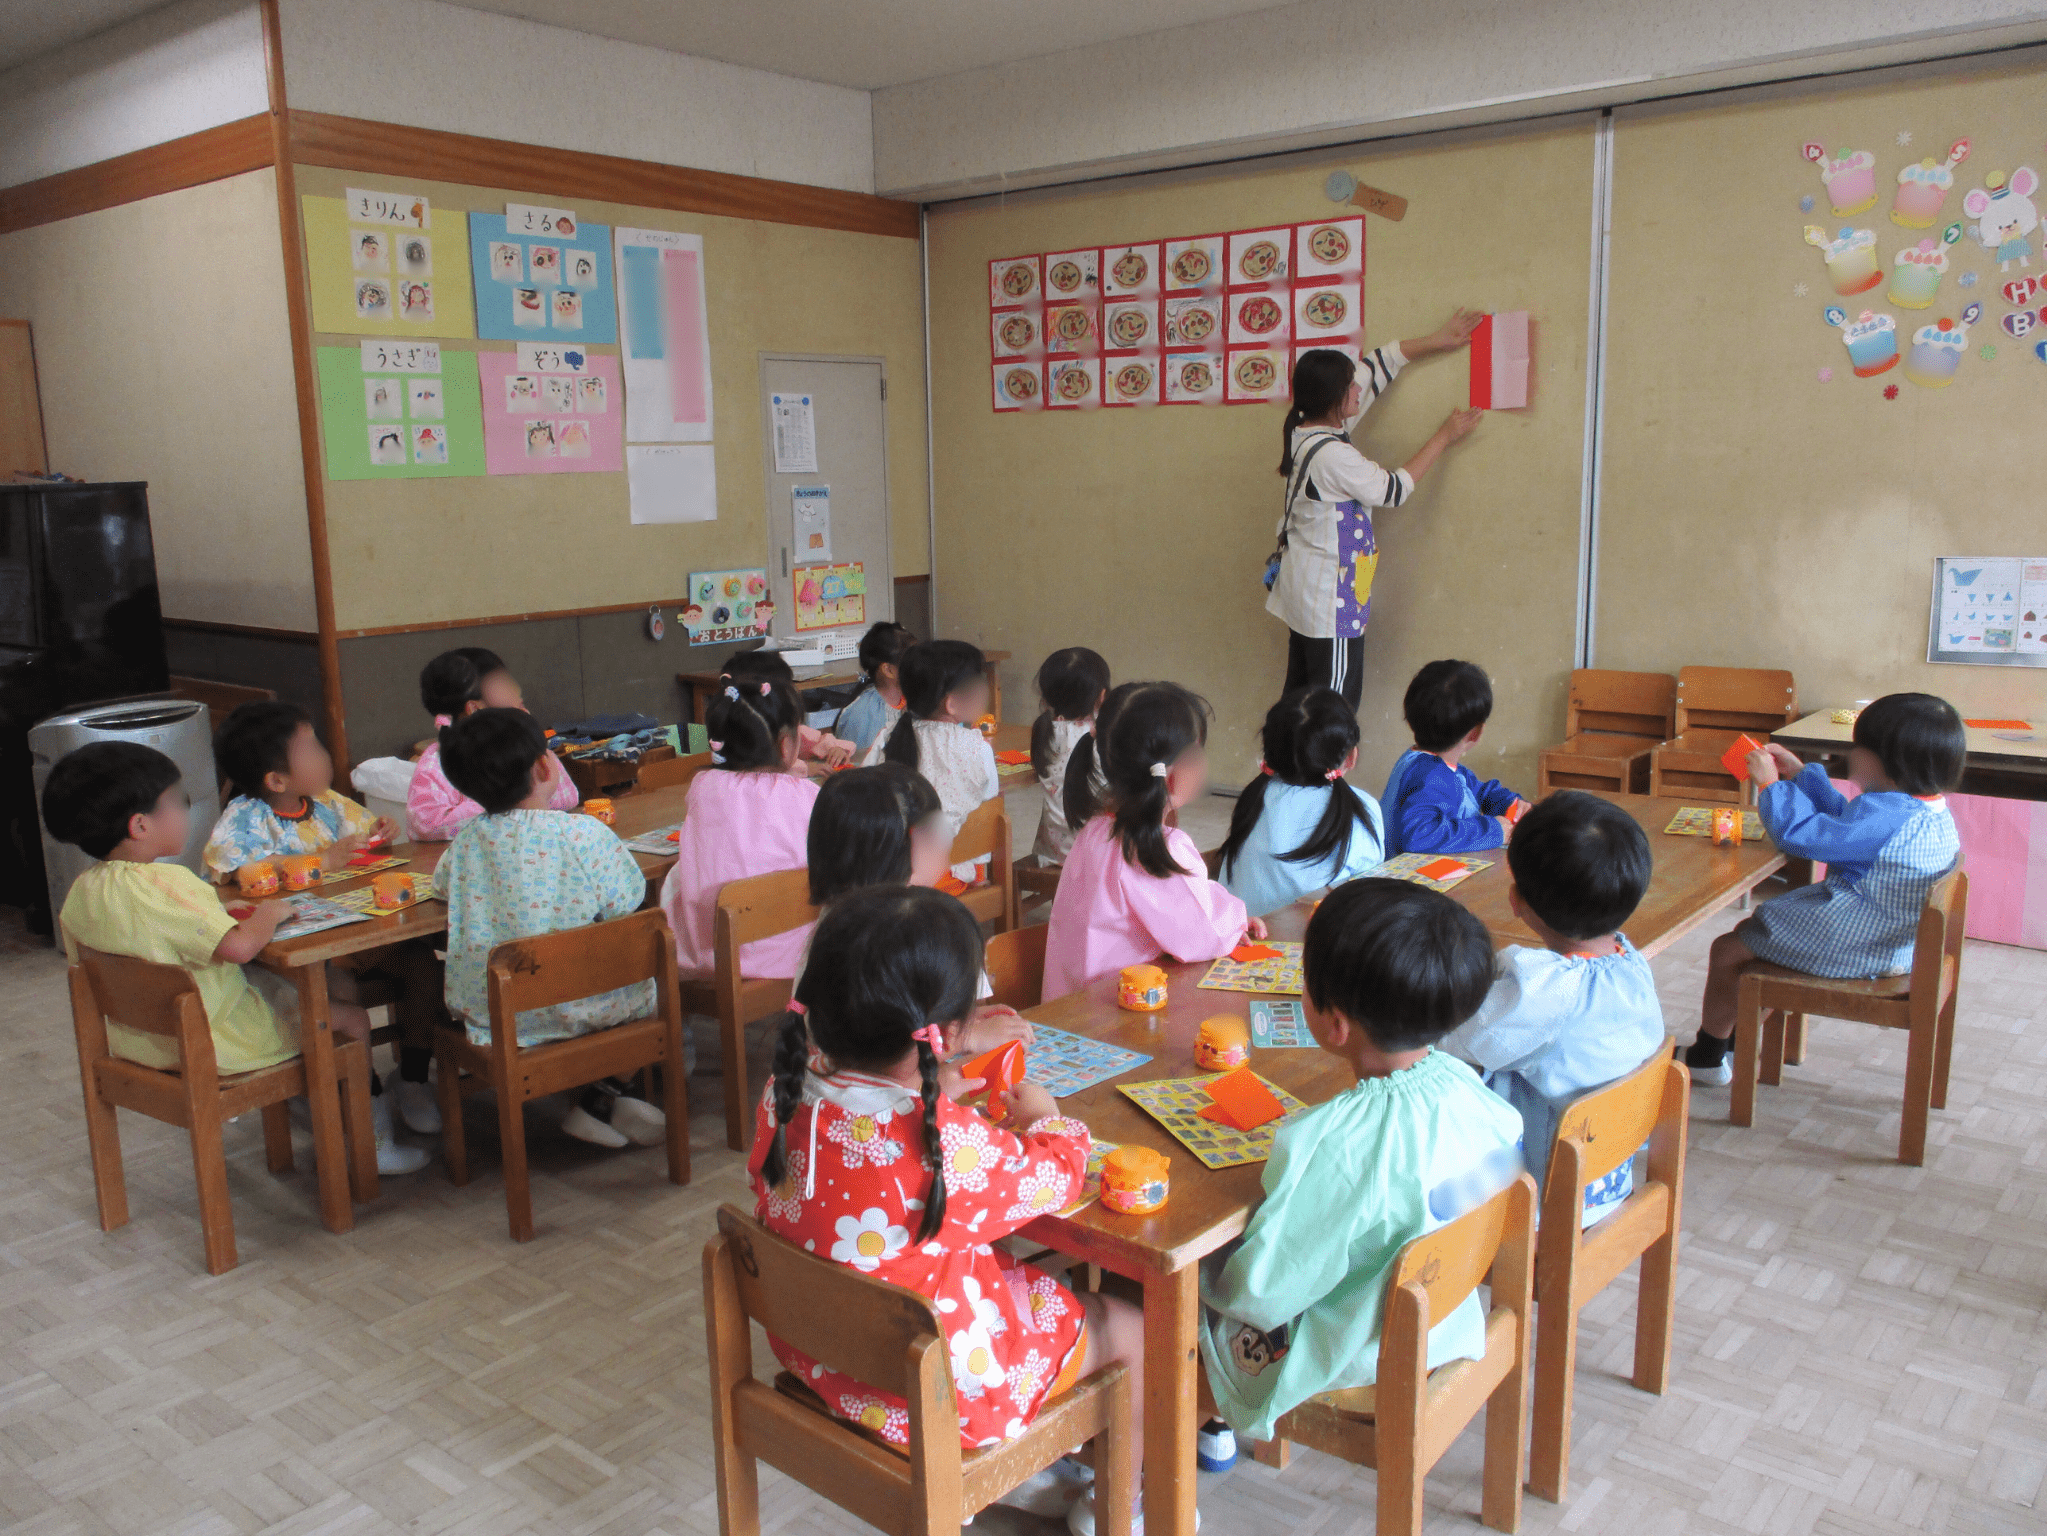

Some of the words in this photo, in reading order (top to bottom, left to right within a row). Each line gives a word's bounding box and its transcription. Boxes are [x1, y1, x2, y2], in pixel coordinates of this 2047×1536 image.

[360, 198, 406, 223] きりん
[524, 211, 552, 232] さる
[2010, 280, 2032, 304] H
[1829, 310, 1844, 324] 8
[2013, 314, 2031, 336] B
[377, 347, 422, 368] うさぎ
[534, 350, 561, 371] ぞう
[825, 582, 840, 594] 27
[700, 625, 758, 642] おとうばん
